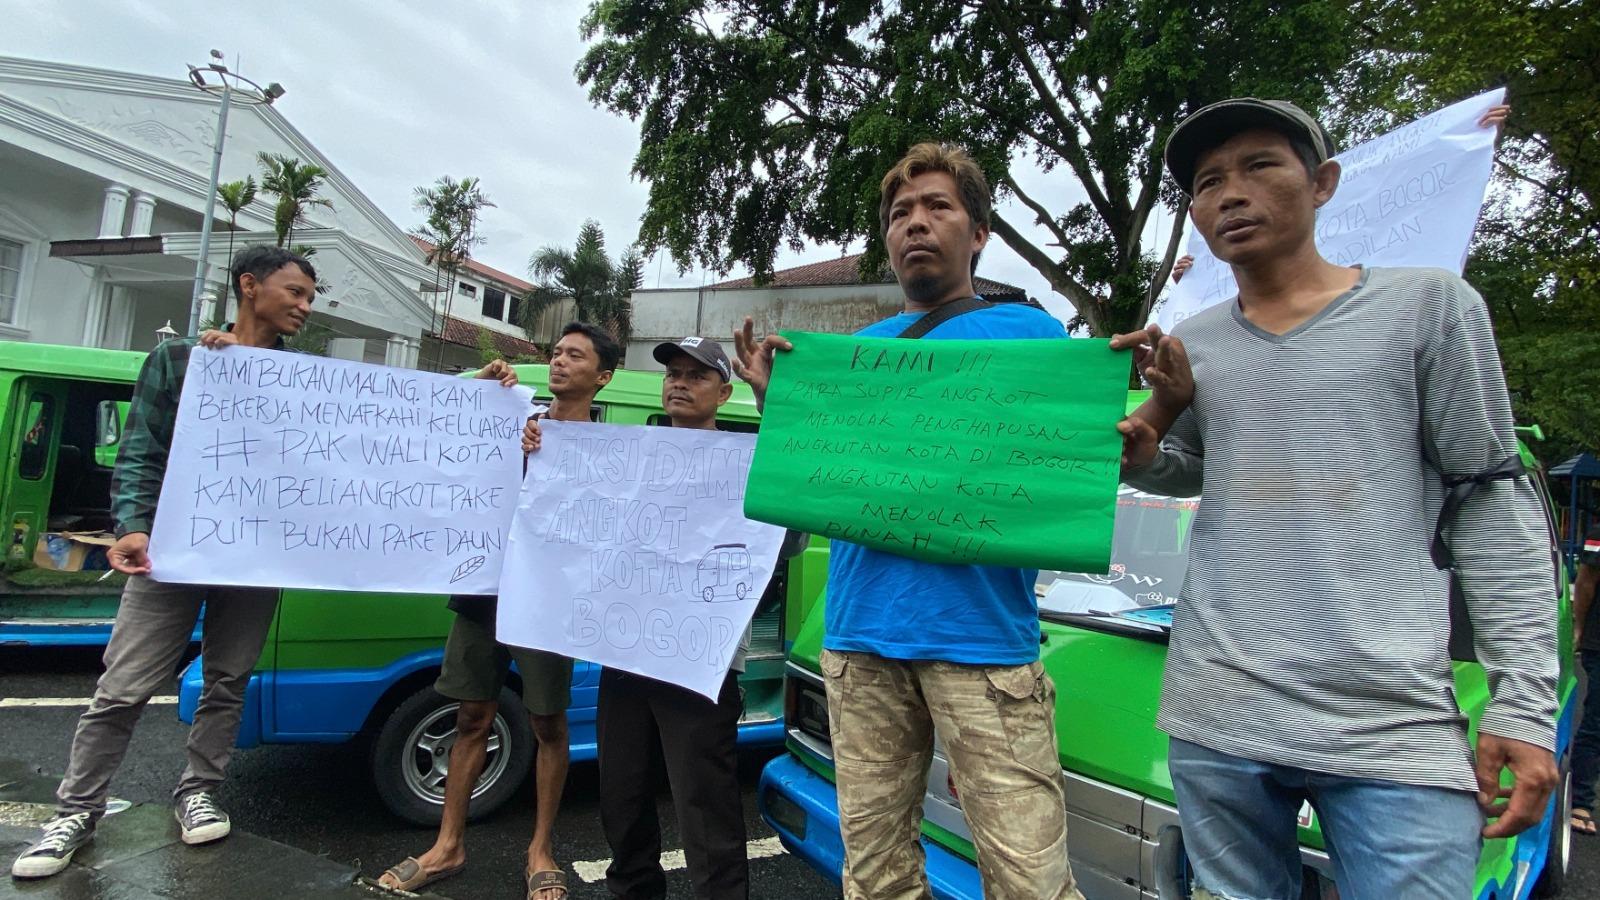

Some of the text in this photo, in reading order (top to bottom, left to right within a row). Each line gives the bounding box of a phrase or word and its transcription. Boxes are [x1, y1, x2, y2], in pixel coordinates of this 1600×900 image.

[1377, 161, 1457, 219] BOGOR
[255, 357, 336, 395] BUKAN
[850, 344, 934, 374] KAMI
[785, 380, 1049, 407] PARA SUPIR ANGKOT
[197, 393, 292, 425] BEKERJA
[426, 414, 522, 440] KELUARGA
[804, 409, 1079, 441] MENOLAK PENGHAPUSAN
[274, 428, 348, 464] PAK
[437, 442, 504, 465] KOTA
[547, 437, 639, 486] AKSI
[783, 437, 890, 457] ANGKUTAN
[905, 445, 960, 463] KOTA
[1006, 450, 1095, 474] BOGOR
[194, 474, 267, 508] KAMI
[339, 479, 441, 510] ANGKOT
[447, 484, 504, 513] PAKE
[808, 466, 1033, 504] ANGKUTAN KOTA
[280, 519, 372, 551] BUKAN
[379, 523, 437, 555] PAKE
[444, 527, 501, 556] DAUN
[544, 496, 688, 550] ANGKOT
[824, 521, 931, 551] PUNAH
[861, 502, 1003, 536] MENOLAK
[590, 548, 683, 596] KOTA
[571, 597, 734, 676] BOGOR
